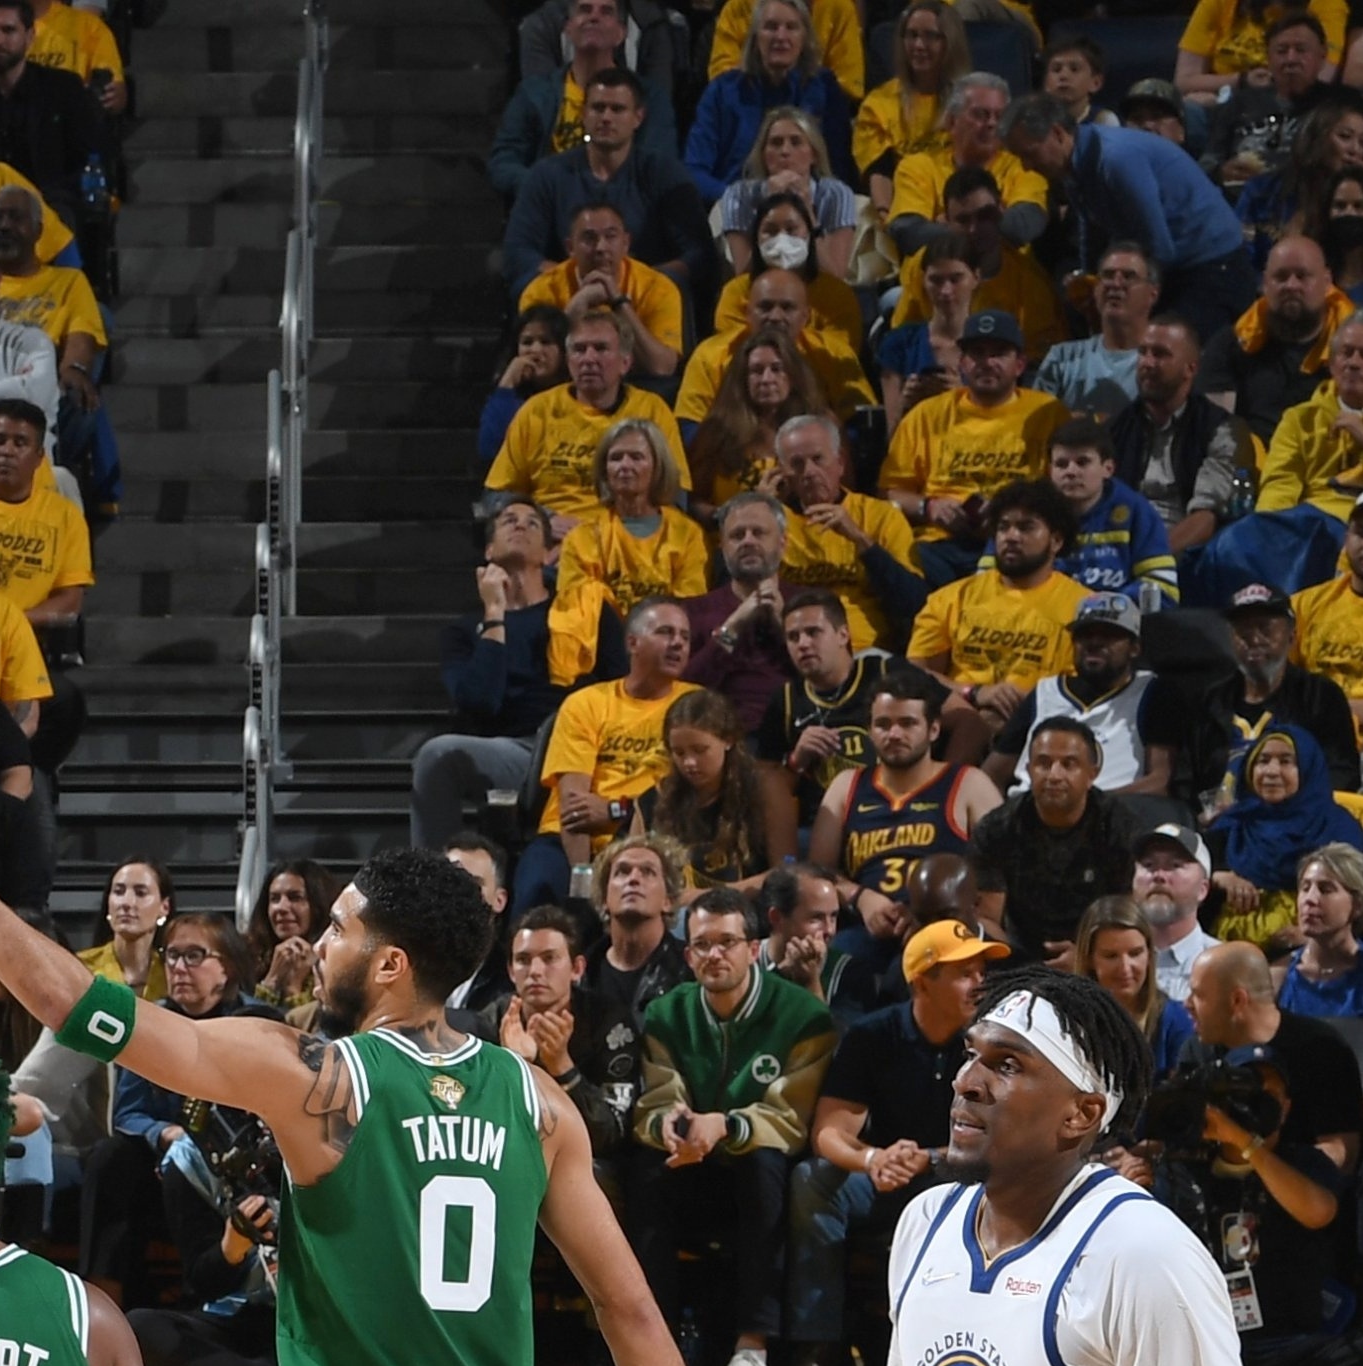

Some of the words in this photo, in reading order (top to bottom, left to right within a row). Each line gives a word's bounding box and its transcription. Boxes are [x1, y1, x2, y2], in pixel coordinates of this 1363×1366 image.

[967, 625, 1048, 651] BLOODED
[843, 734, 865, 756] 11
[847, 822, 935, 862] OAKLAND
[87, 1010, 126, 1045] 0
[401, 1114, 507, 1171] TATUM
[420, 1174, 497, 1313] 0
[1005, 1277, 1042, 1295] Rakuten
